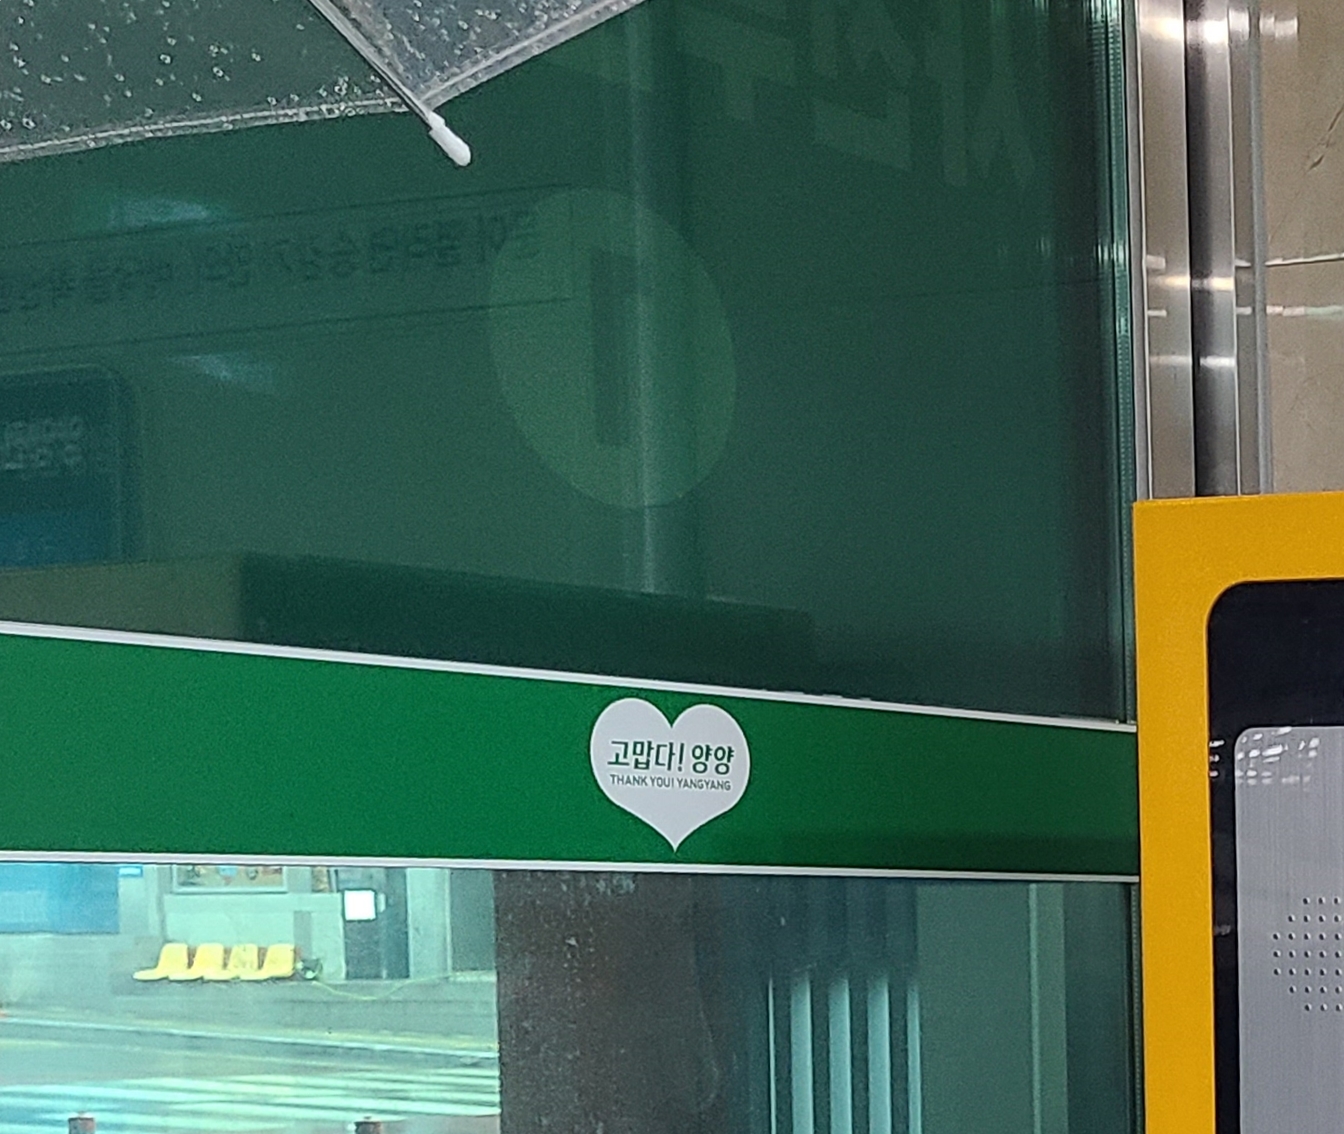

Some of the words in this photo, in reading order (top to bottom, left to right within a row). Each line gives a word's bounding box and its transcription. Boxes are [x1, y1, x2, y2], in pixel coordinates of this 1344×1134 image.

[607, 740, 684, 772] 고맙다!
[691, 744, 734, 775] 양양
[609, 774, 648, 786] THANK
[676, 777, 731, 791] YANGYANG
